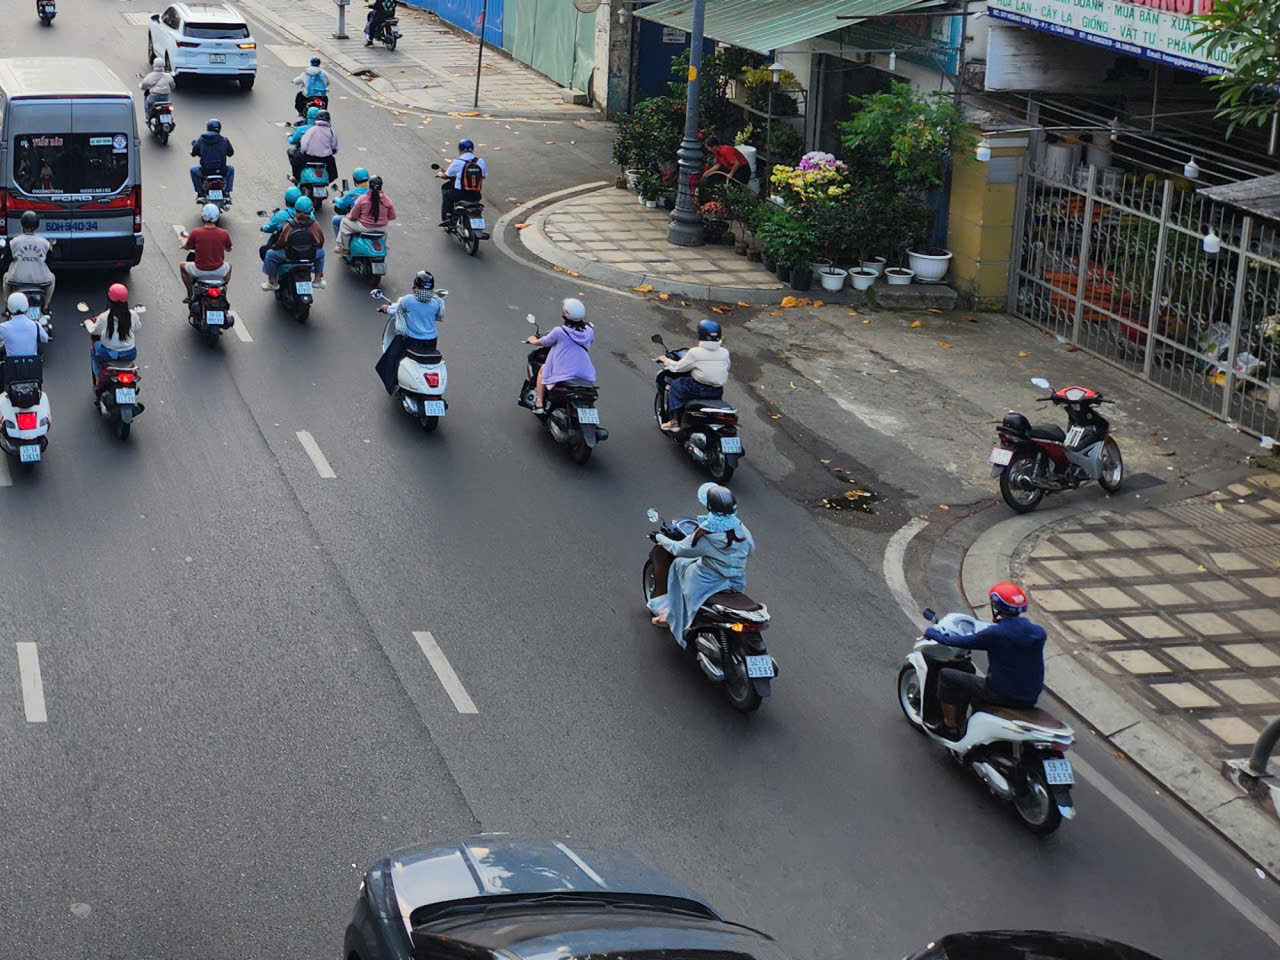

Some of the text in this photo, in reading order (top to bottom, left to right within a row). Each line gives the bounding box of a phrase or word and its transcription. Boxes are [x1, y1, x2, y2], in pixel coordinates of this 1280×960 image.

[1015, 0, 1032, 13] LAN
[1120, 24, 1139, 41] VẬT
[1114, 3, 1135, 20] MUA
